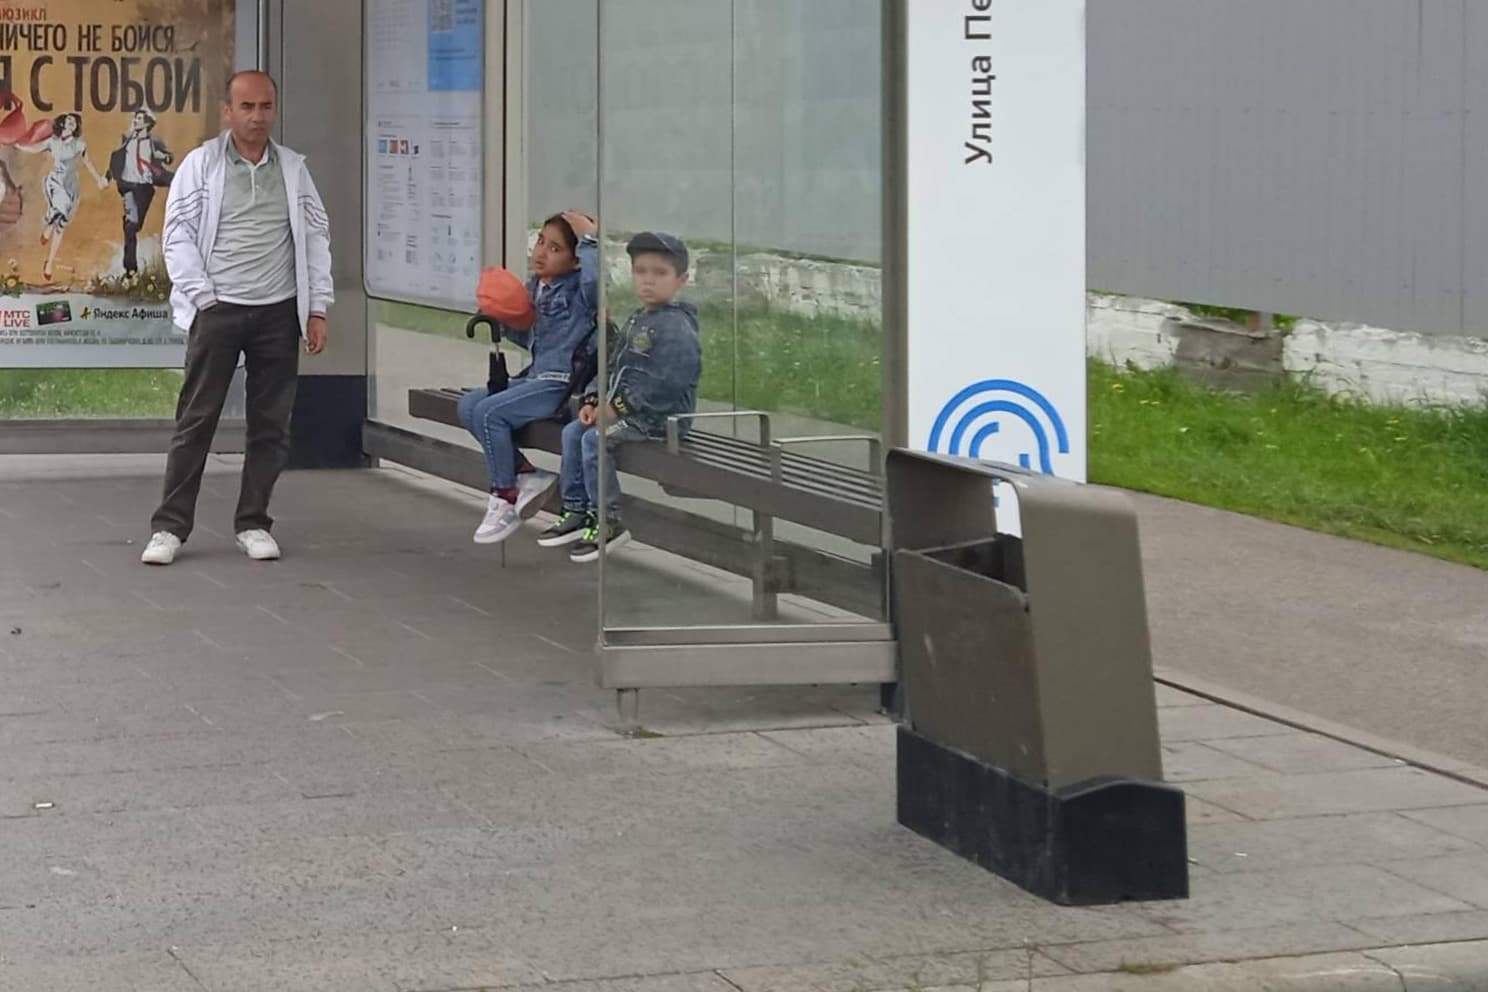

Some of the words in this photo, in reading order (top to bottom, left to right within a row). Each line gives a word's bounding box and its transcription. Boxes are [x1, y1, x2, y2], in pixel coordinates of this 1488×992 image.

[77, 23, 102, 52] НЕ
[30, 54, 54, 113] С
[964, 55, 996, 165] Улица
[3, 319, 31, 328] LIVE
[93, 307, 130, 320] Яндекс
[131, 307, 169, 320] Афиша
